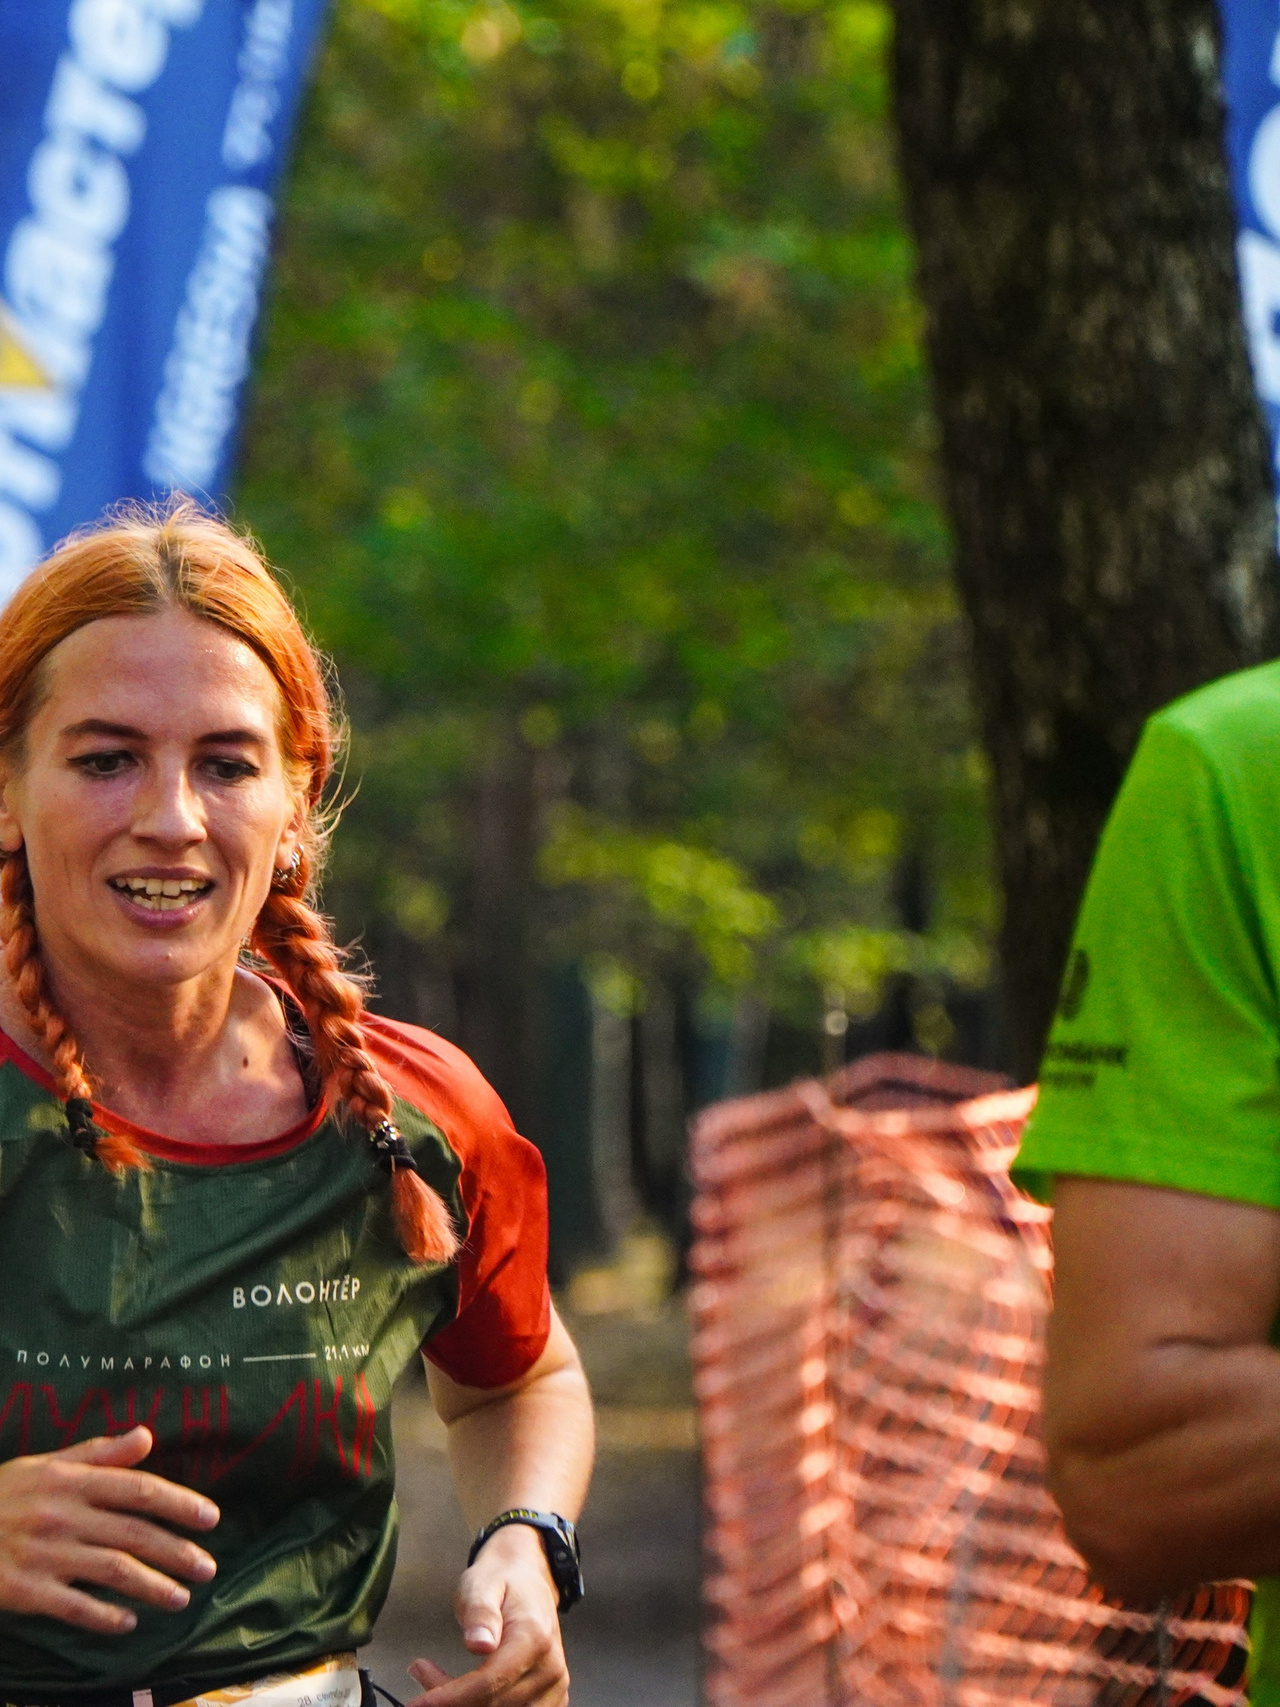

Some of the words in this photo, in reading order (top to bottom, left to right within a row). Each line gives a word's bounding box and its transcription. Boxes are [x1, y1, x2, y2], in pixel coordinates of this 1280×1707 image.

[232, 1274, 361, 1309] ВОЛОНТЁР
[16, 1349, 231, 1371] ПОЛУМАРАФОН
[324, 1344, 349, 1361] 21,1
